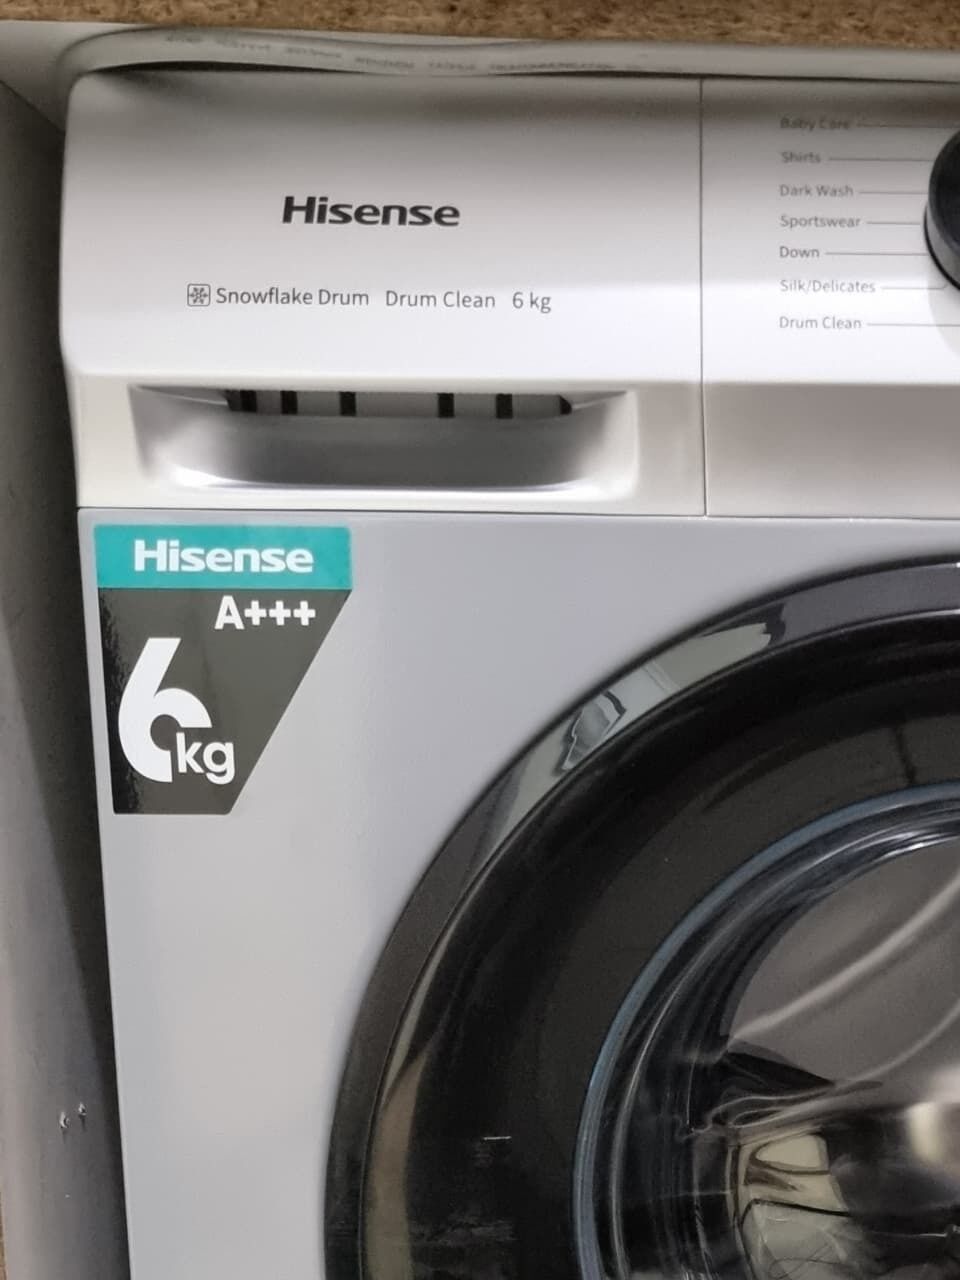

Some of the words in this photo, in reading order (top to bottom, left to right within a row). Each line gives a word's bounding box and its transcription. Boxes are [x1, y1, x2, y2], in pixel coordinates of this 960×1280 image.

[780, 151, 822, 164] Shirts
[779, 184, 812, 197] Dark
[816, 184, 854, 197] Wash
[282, 196, 461, 227] Hisense
[780, 214, 861, 230] Sportswear
[779, 245, 820, 259] Down
[780, 279, 876, 294] Silk/Delicates
[215, 287, 313, 306] Snowflake
[318, 289, 370, 306] Drum
[385, 290, 437, 308] Drum
[443, 291, 496, 308] Clean
[512, 292, 524, 309] 6
[529, 291, 552, 314] kg
[779, 315, 819, 330] Drum
[822, 315, 862, 330] Clean
[134, 539, 314, 573] Hisense
[214, 595, 316, 630] A+++
[118, 637, 213, 783] 6
[175, 732, 236, 785] kg
